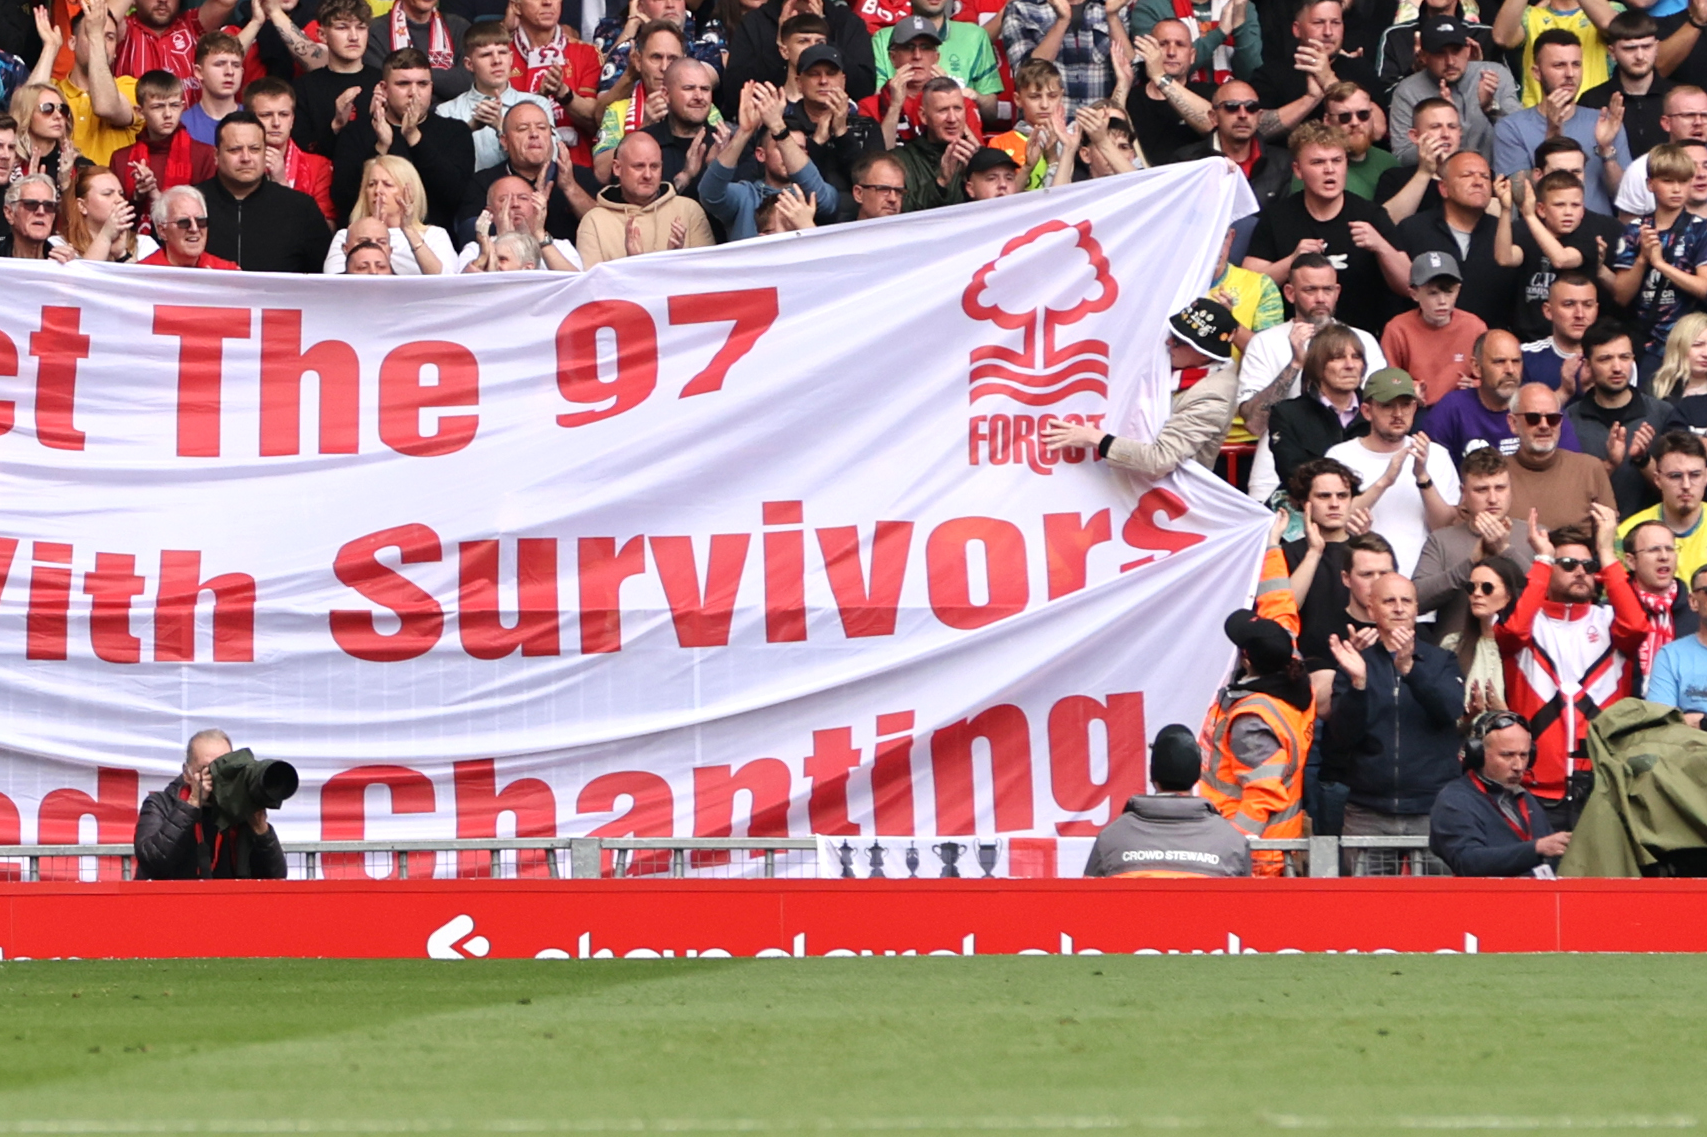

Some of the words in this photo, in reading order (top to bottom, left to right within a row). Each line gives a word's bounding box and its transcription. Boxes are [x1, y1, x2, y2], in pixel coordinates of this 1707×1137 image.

[153, 304, 480, 458] The
[555, 287, 780, 429] 97
[329, 488, 1206, 663] Survivors
[320, 691, 1147, 880] Chanting
[1122, 850, 1164, 862] CROWD
[1165, 850, 1220, 865] STEWARD
